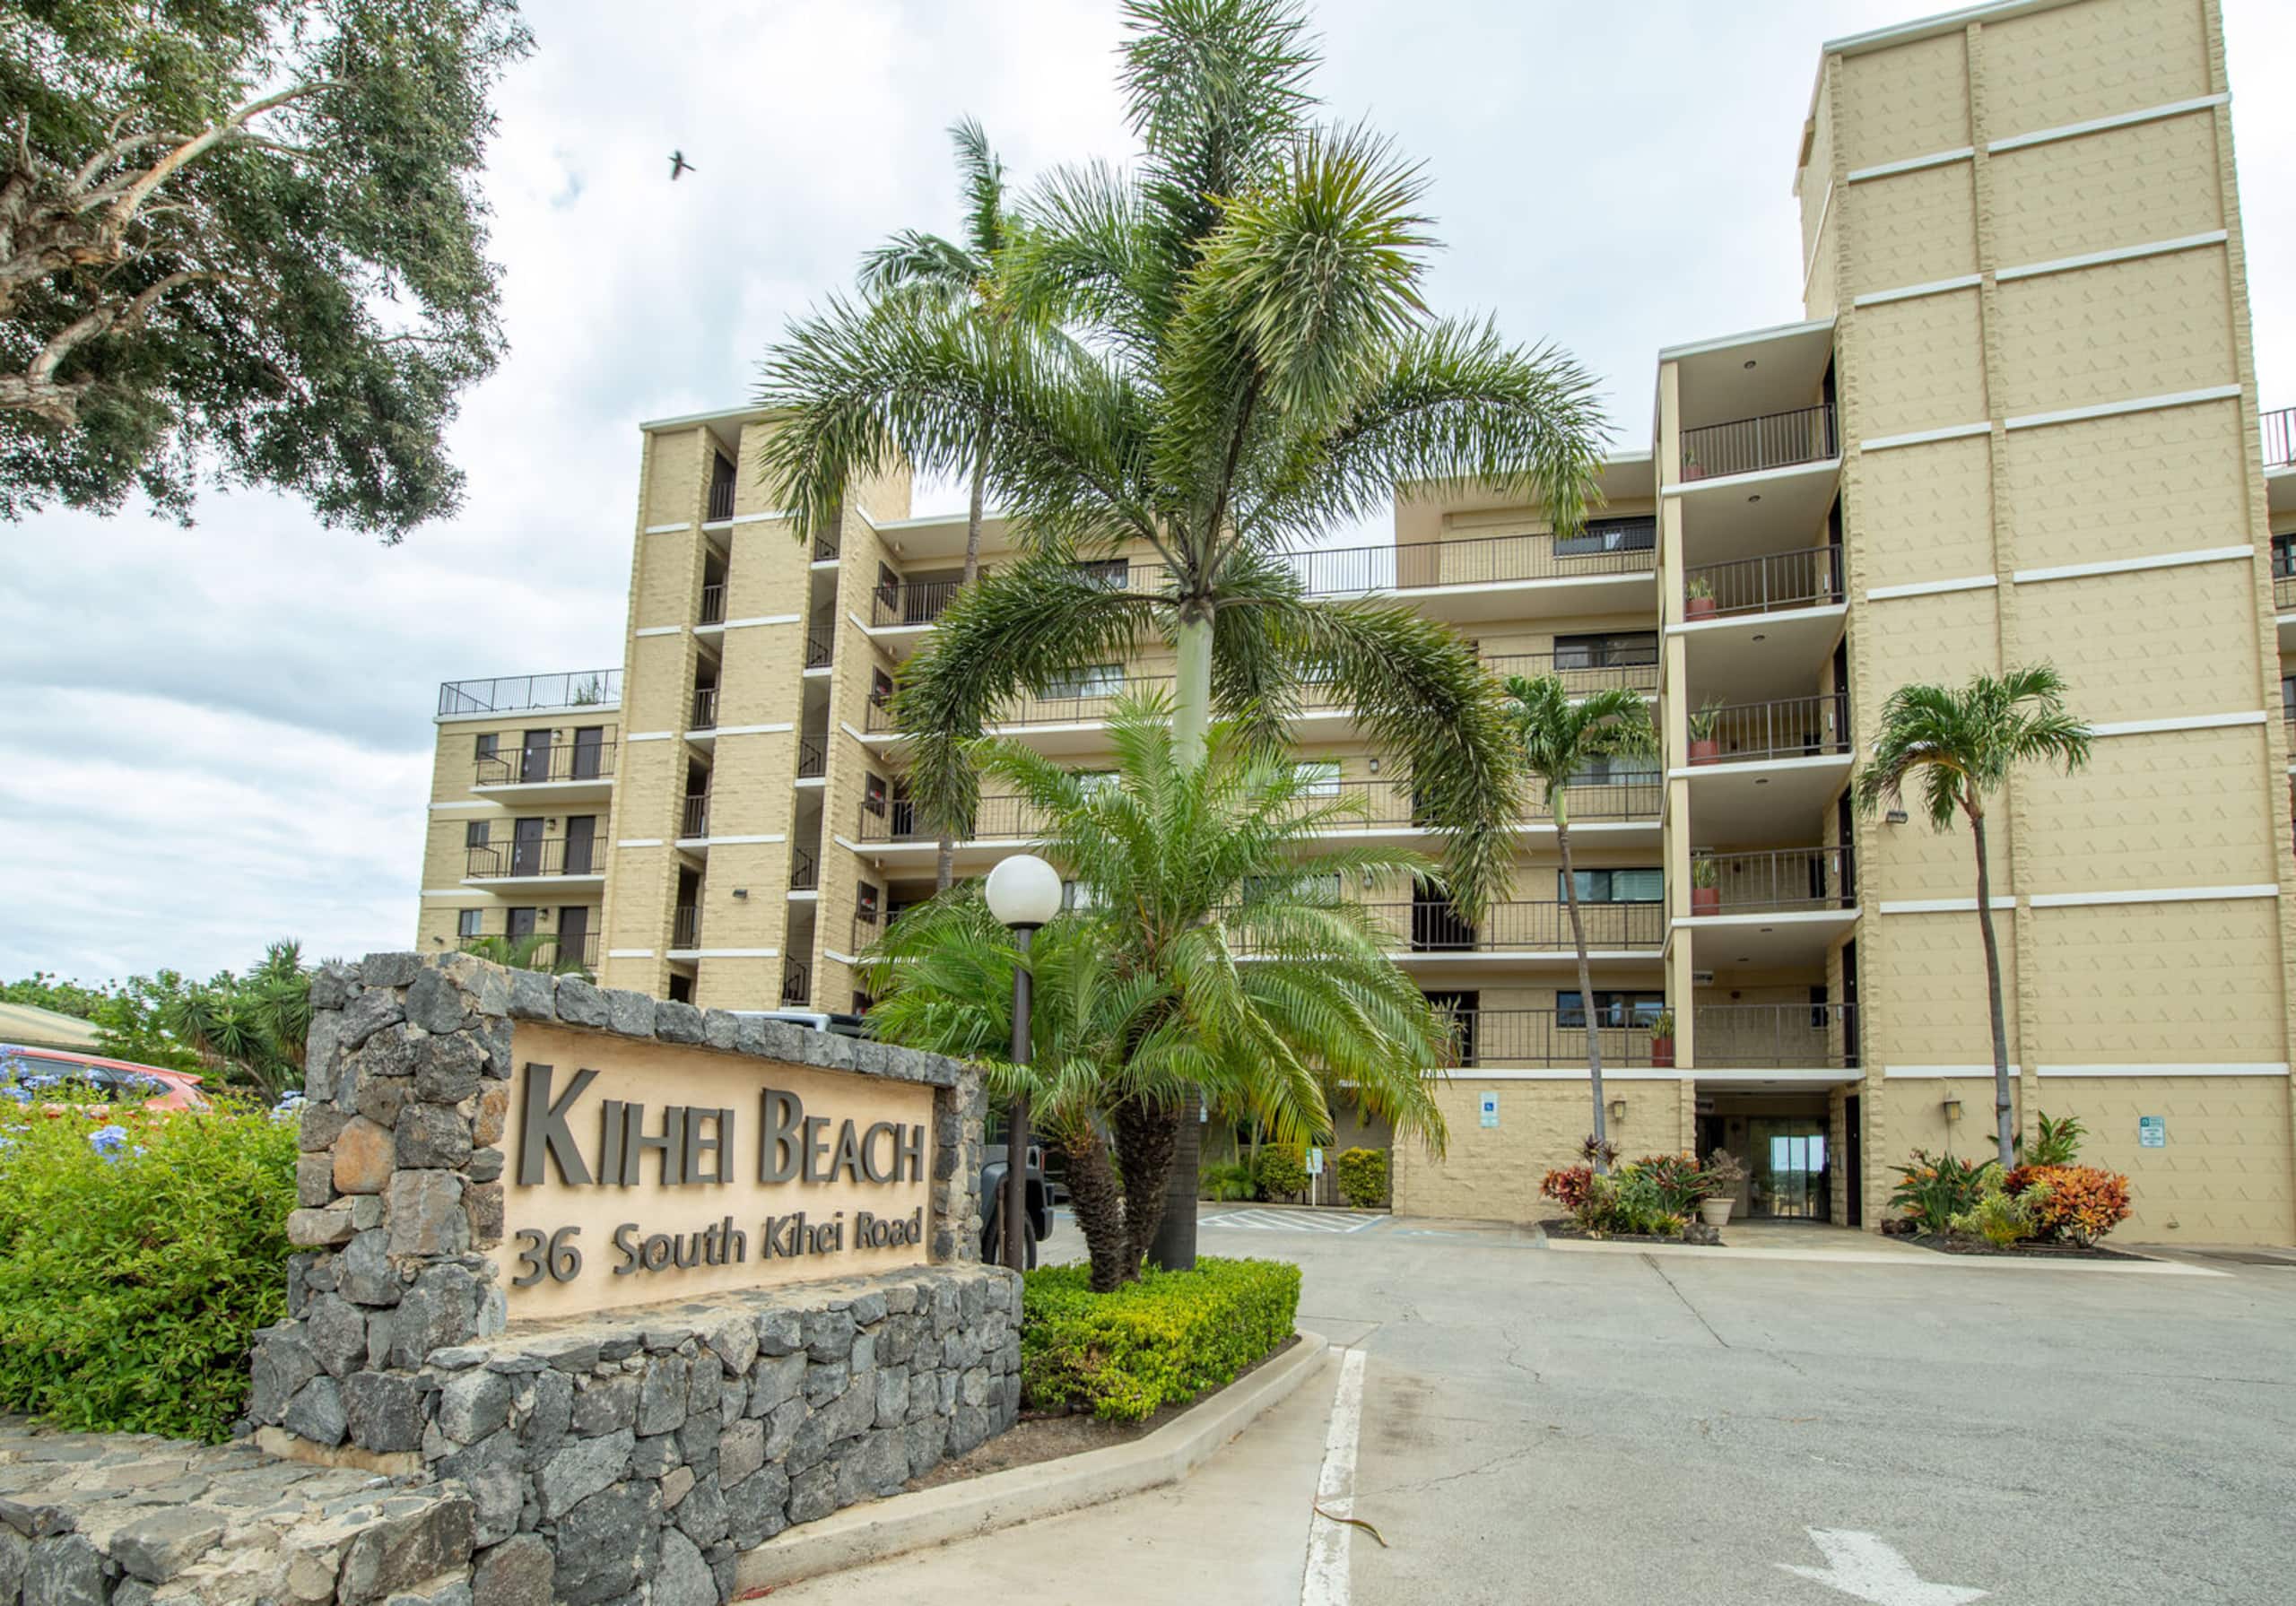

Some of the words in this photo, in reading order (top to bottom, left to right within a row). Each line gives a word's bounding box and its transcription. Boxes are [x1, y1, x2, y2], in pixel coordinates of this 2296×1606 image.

[517, 1062, 735, 1185] KIHEI
[759, 1087, 925, 1184] BEACH
[513, 1226, 582, 1286] 36
[613, 1216, 747, 1275] South
[763, 1211, 844, 1259] Kihei
[855, 1206, 923, 1249] Road
